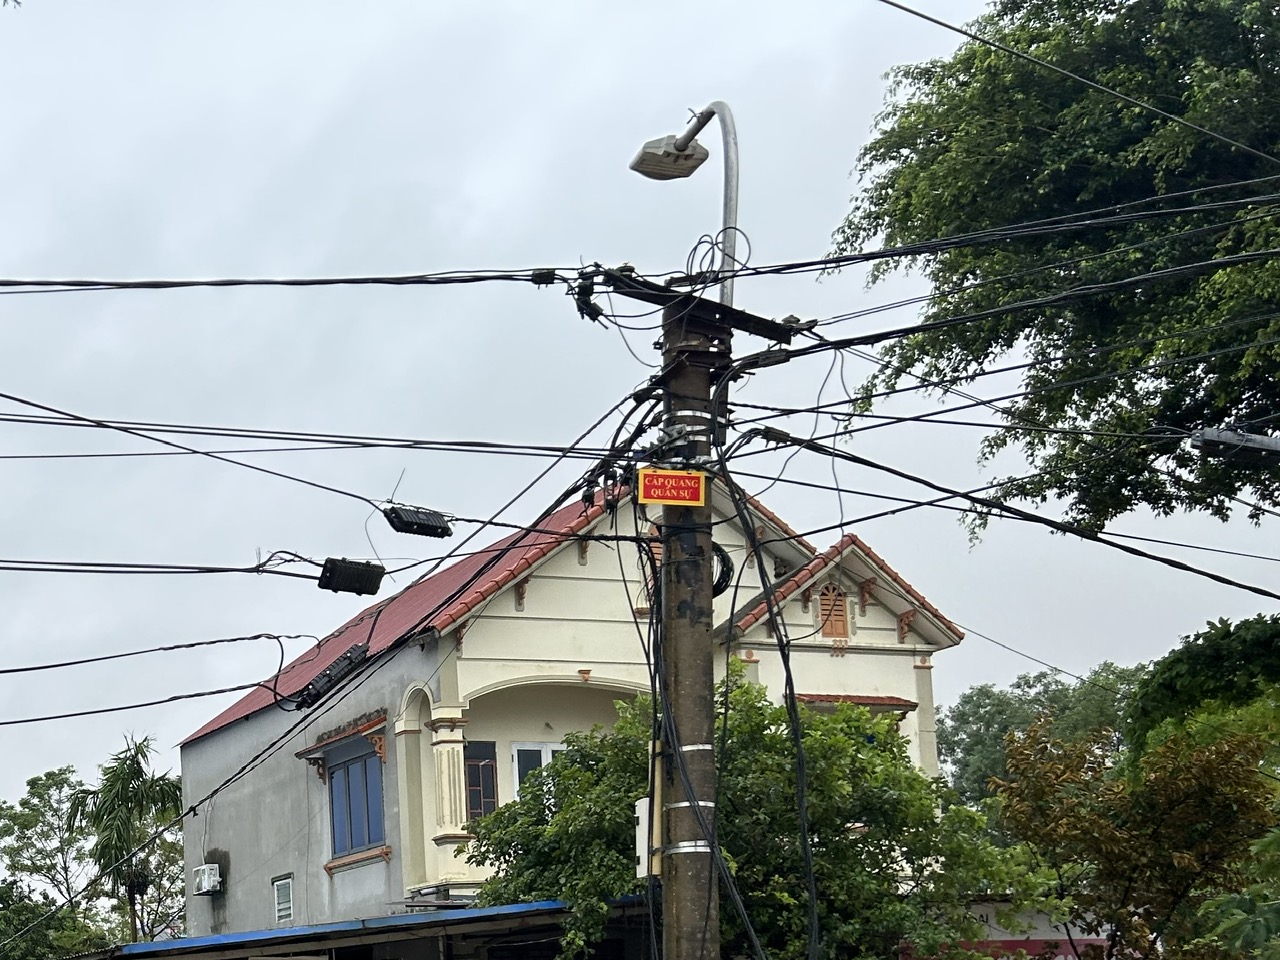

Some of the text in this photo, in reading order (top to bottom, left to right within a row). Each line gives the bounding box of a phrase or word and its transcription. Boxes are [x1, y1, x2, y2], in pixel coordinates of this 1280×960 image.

[645, 476, 699, 489] CÁP QUANG
[679, 488, 692, 499] SỰ
